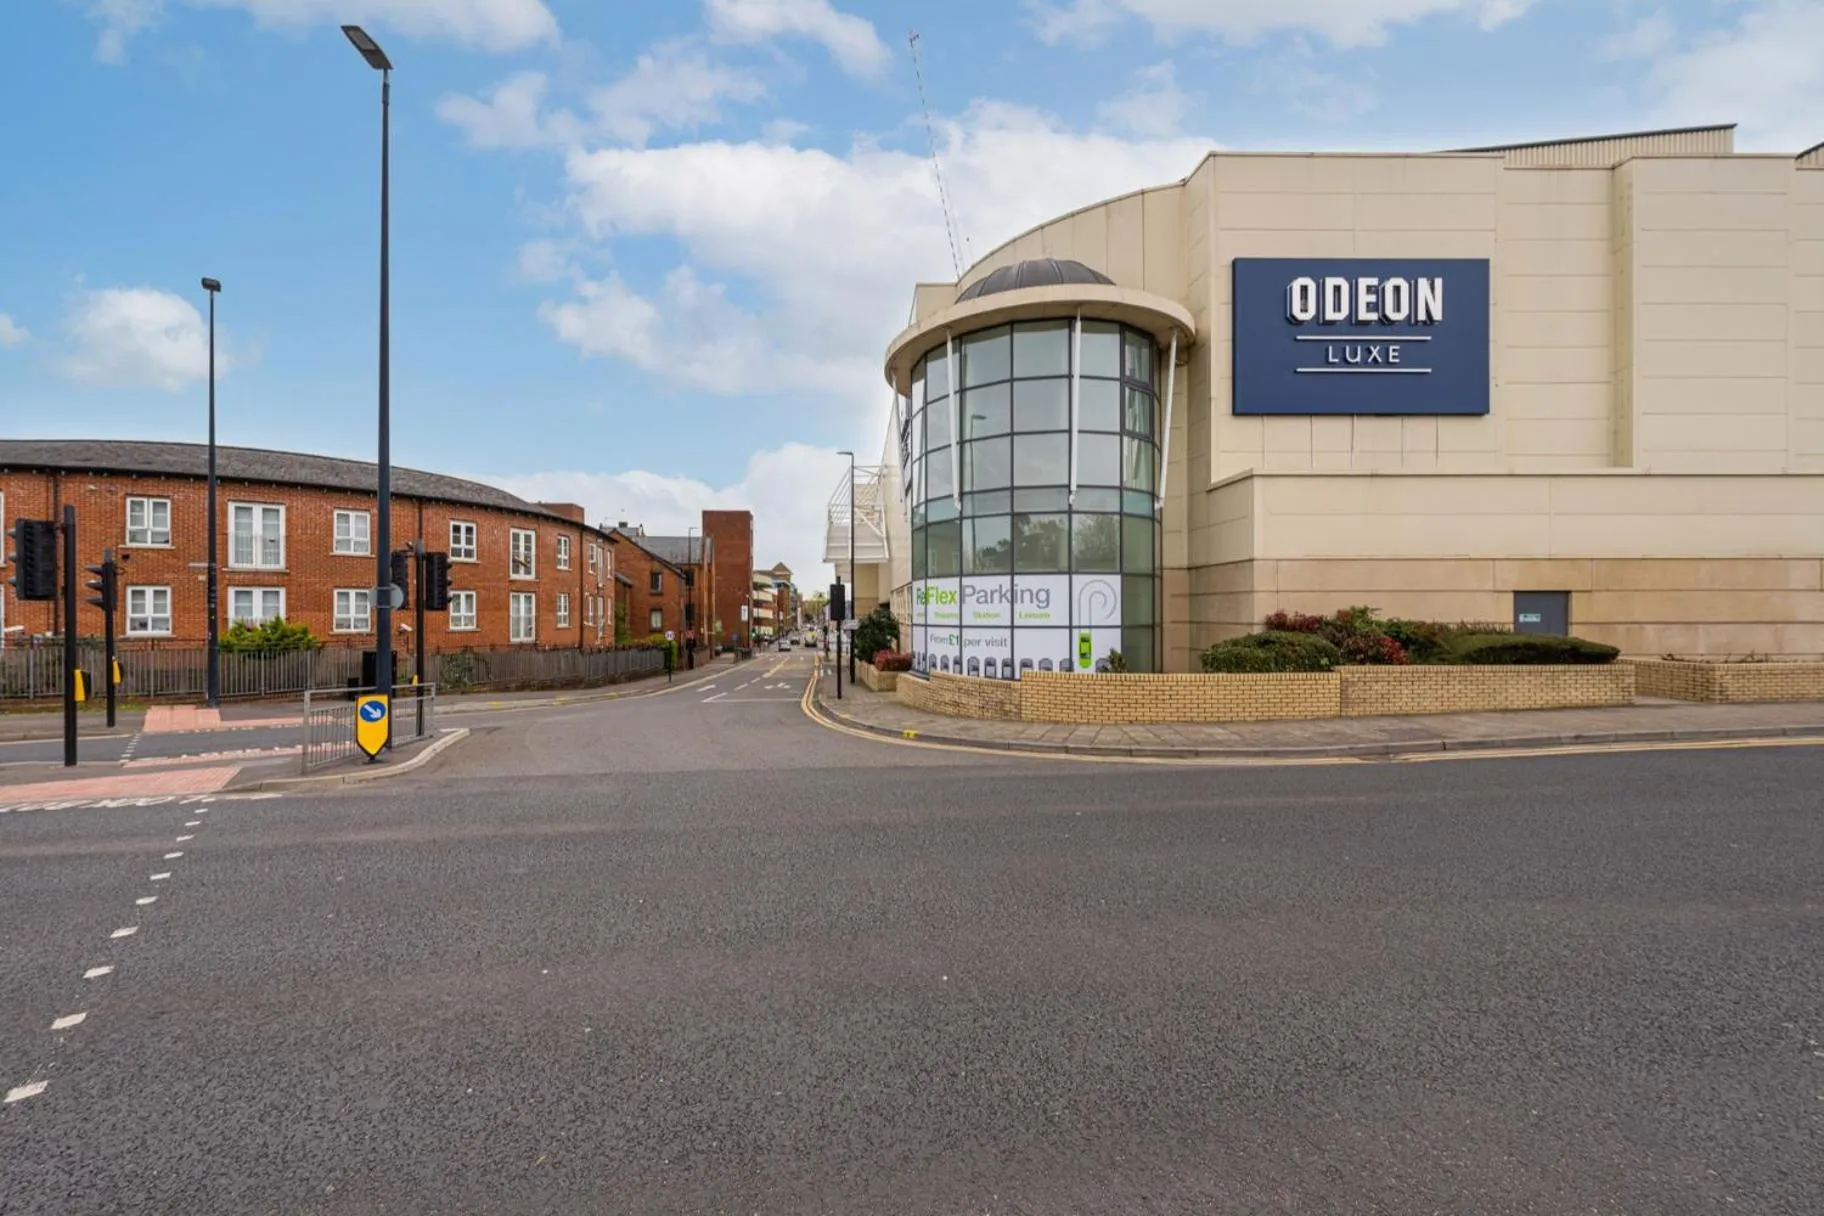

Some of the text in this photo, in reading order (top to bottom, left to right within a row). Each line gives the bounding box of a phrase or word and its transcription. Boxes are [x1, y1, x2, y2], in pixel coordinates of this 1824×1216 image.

[1287, 276, 1443, 324] ODEON
[1328, 345, 1401, 363] LUXE
[961, 584, 1050, 609] Parking
[963, 637, 981, 648] per
[985, 636, 1008, 648] visit
